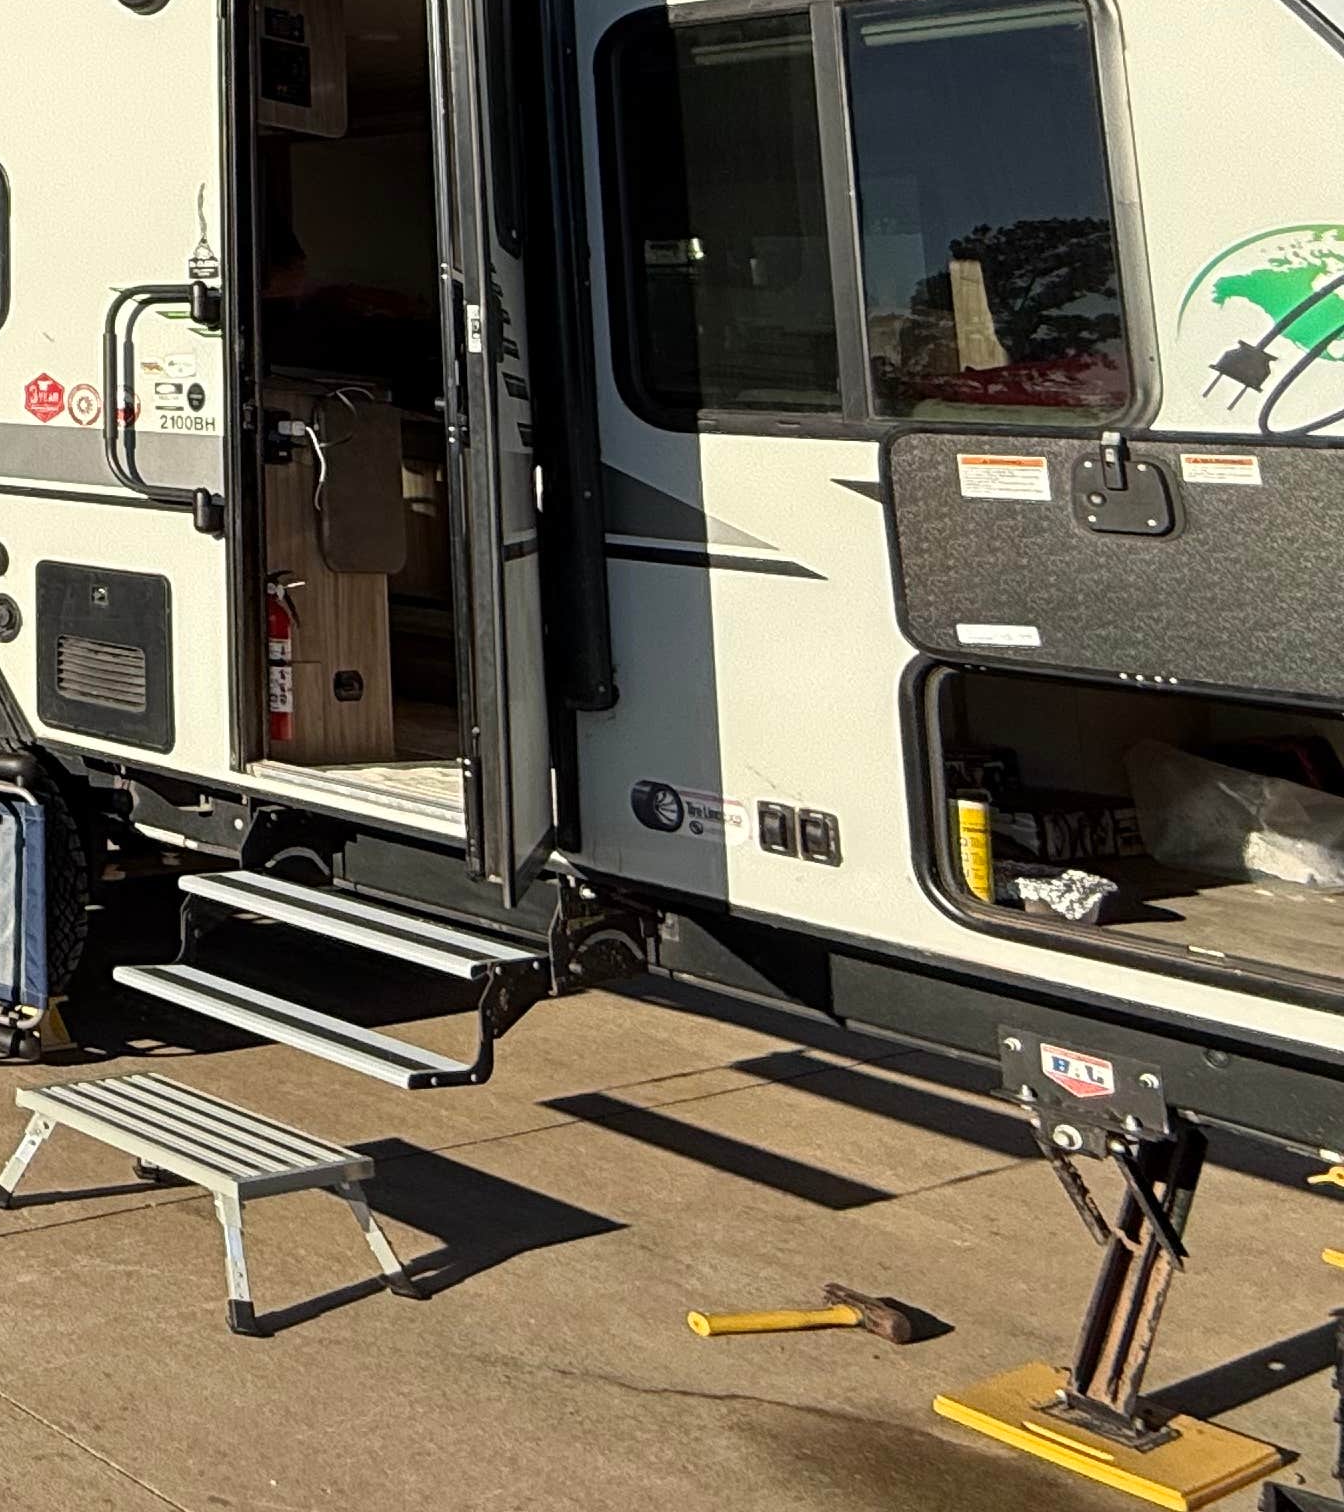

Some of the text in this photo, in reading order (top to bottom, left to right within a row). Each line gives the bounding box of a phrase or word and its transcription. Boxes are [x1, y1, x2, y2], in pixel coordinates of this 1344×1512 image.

[29, 385, 39, 403] 3
[160, 414, 216, 432] 2100BH
[1052, 1055, 1104, 1085] BL
